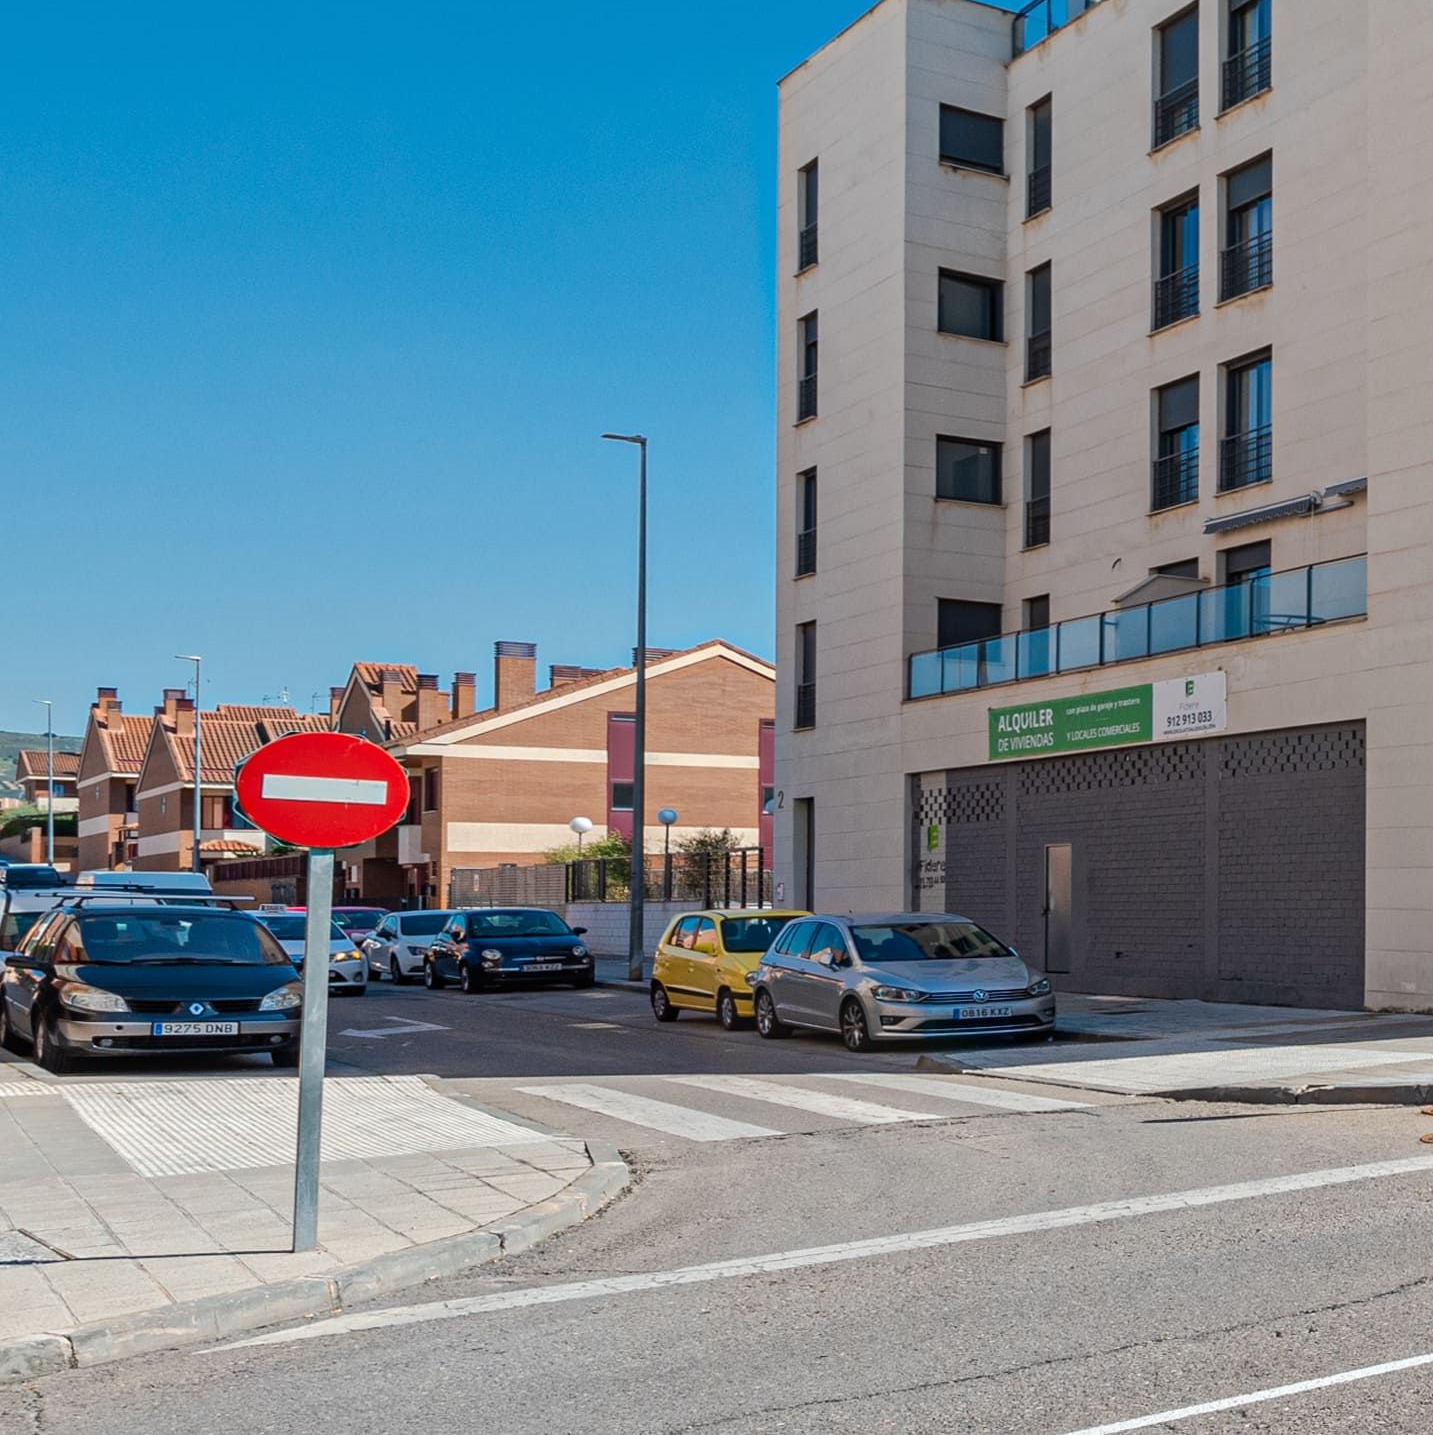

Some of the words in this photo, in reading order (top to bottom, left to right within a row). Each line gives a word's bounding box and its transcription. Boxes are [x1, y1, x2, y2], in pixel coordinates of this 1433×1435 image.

[998, 708, 1054, 733] ALQUILER
[1167, 715, 1181, 727] 912
[1182, 712, 1196, 725] 913
[1197, 710, 1213, 723] 033
[1066, 732, 1071, 741] Y
[1071, 728, 1097, 741] LOCALES
[1097, 722, 1140, 737] COMERCIALES
[998, 738, 1009, 752] DE
[1010, 732, 1054, 751] VIVIENDAS
[777, 790, 785, 809] 2
[164, 1023, 202, 1034] 9275
[205, 1023, 233, 1033] DNB
